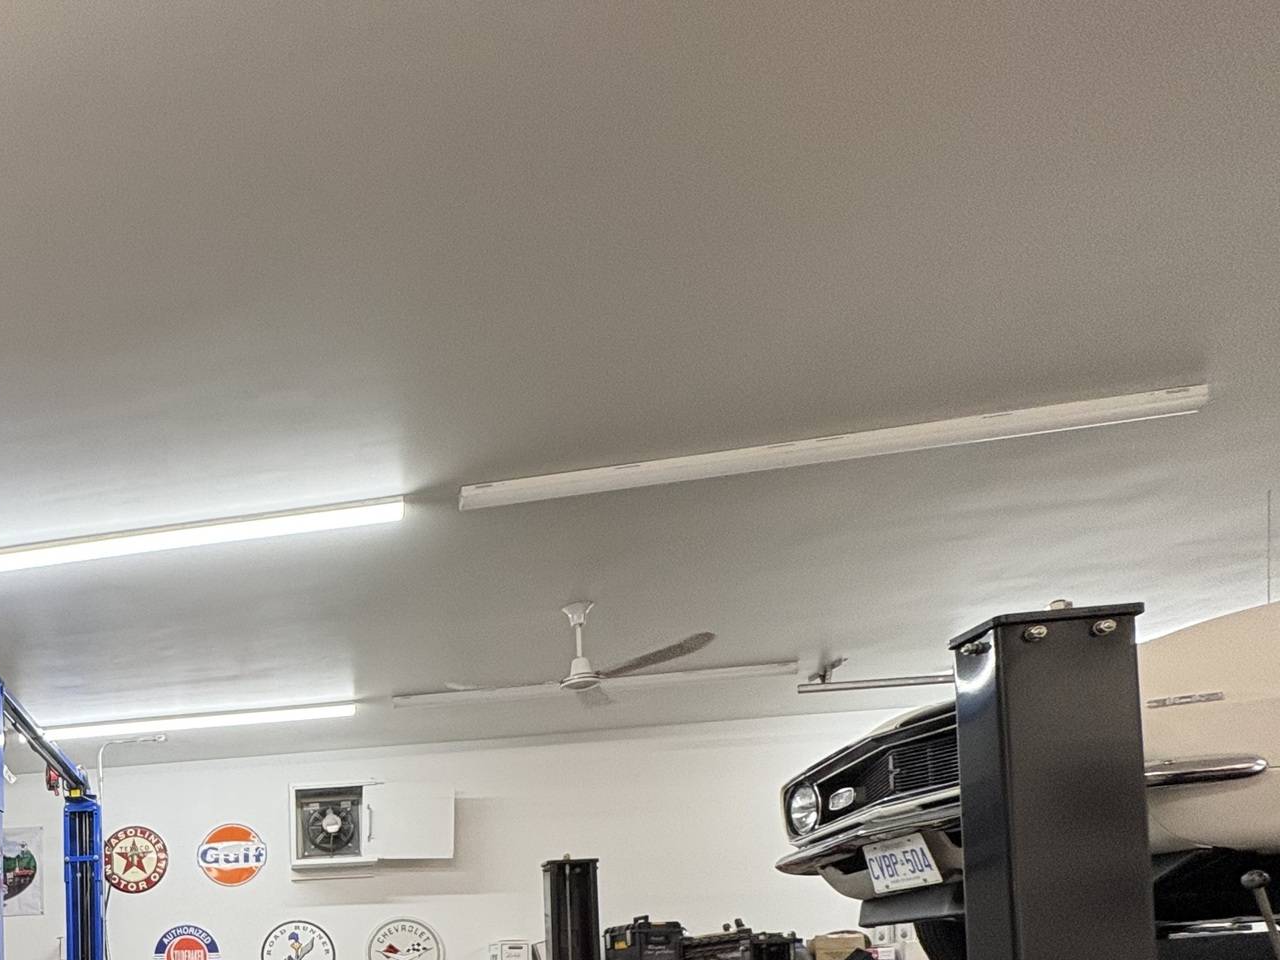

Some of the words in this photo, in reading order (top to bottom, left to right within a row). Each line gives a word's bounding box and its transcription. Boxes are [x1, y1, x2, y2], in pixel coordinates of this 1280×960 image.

[105, 828, 164, 854] GASOLINE
[200, 846, 264, 864] Gulf
[868, 853, 899, 881] CVBP
[902, 847, 933, 874] 504
[105, 864, 148, 891] MOTOR
[162, 926, 211, 945] AUTHORIZED
[266, 928, 287, 956] ROAD
[294, 925, 330, 955] RUNNER
[376, 924, 431, 944] CHEVROLET
